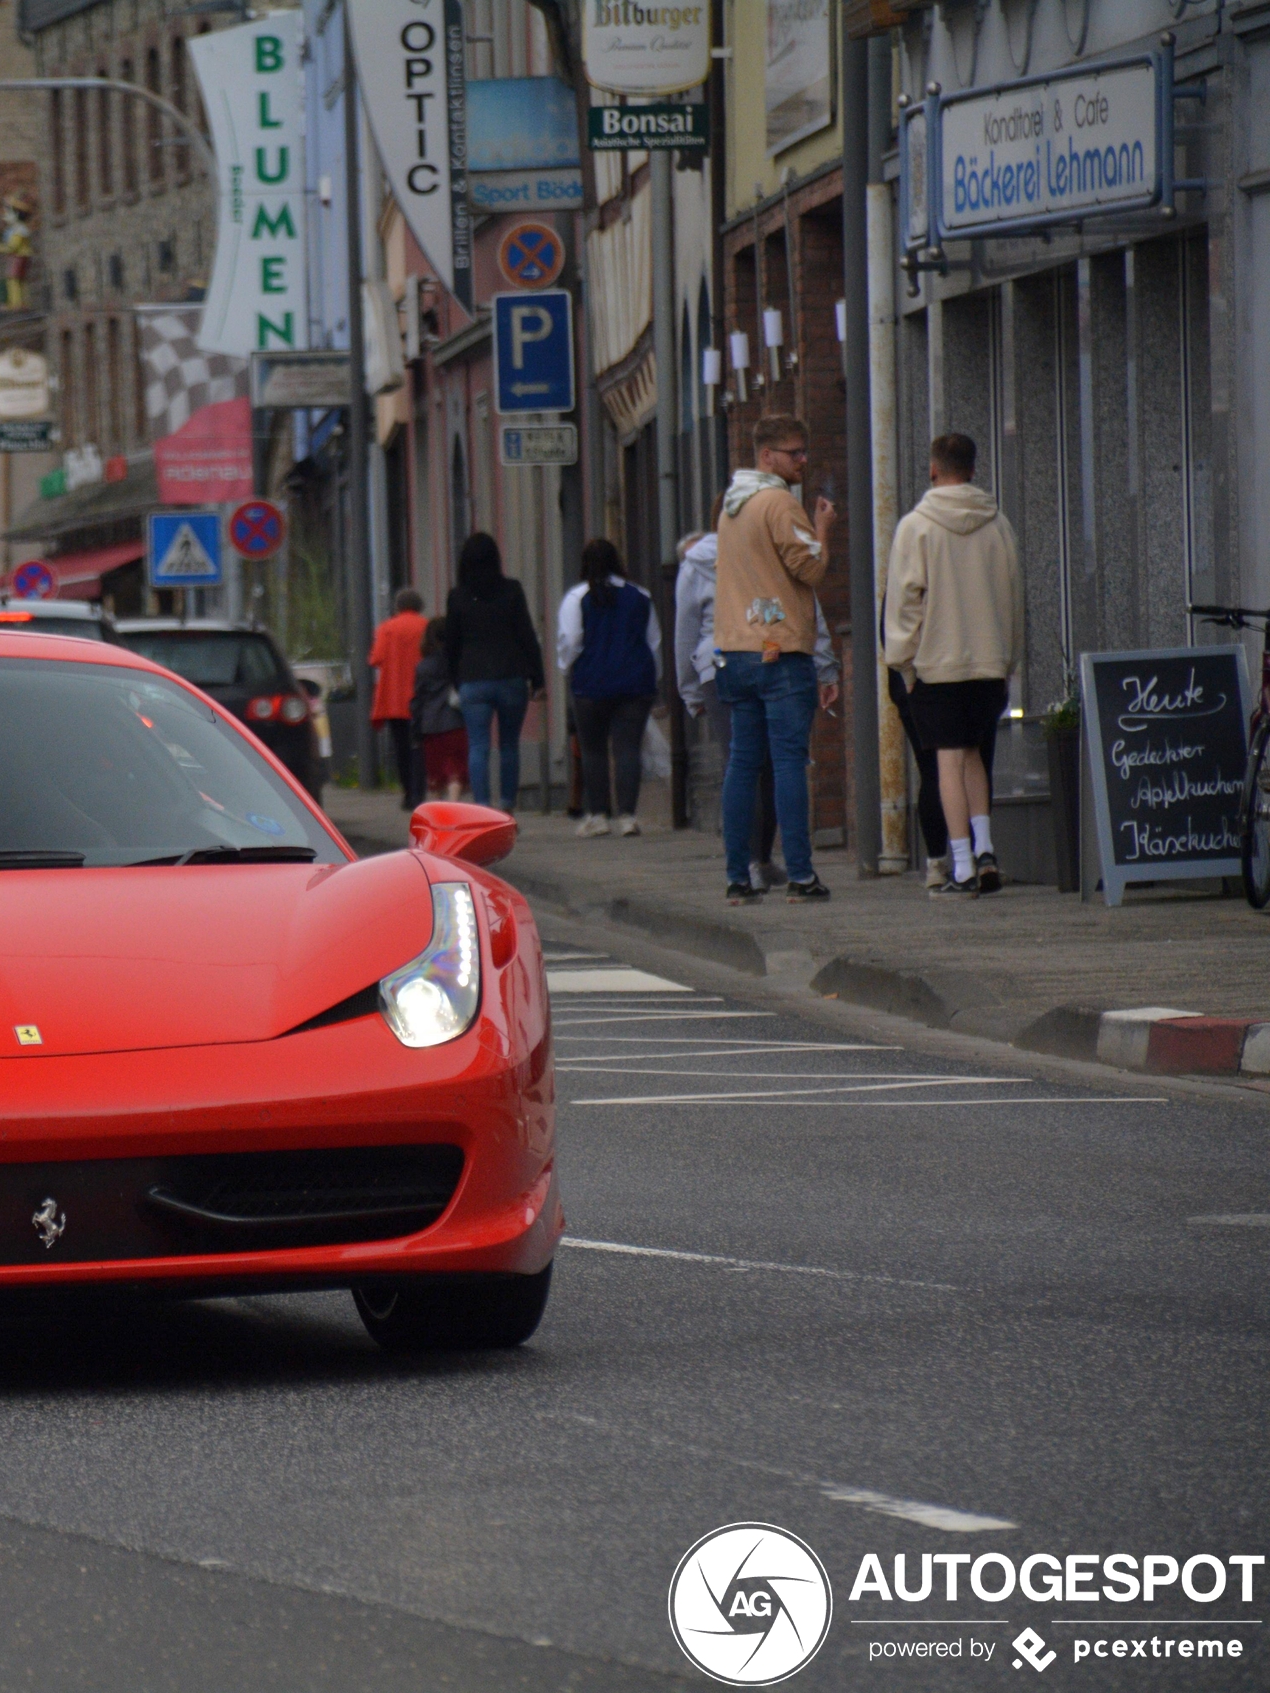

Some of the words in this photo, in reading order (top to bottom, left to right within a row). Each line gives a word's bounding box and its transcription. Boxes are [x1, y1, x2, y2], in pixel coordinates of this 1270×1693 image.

[401, 21, 440, 196] OPTIC
[602, 105, 693, 135] Bonsai
[1053, 100, 1064, 133] &
[251, 35, 297, 350] BLUMEN
[473, 183, 531, 207] Sport
[954, 143, 1041, 213] Bäckerei
[1046, 136, 1144, 197] Lehmann
[511, 304, 554, 371] P
[1122, 666, 1204, 713] Heute
